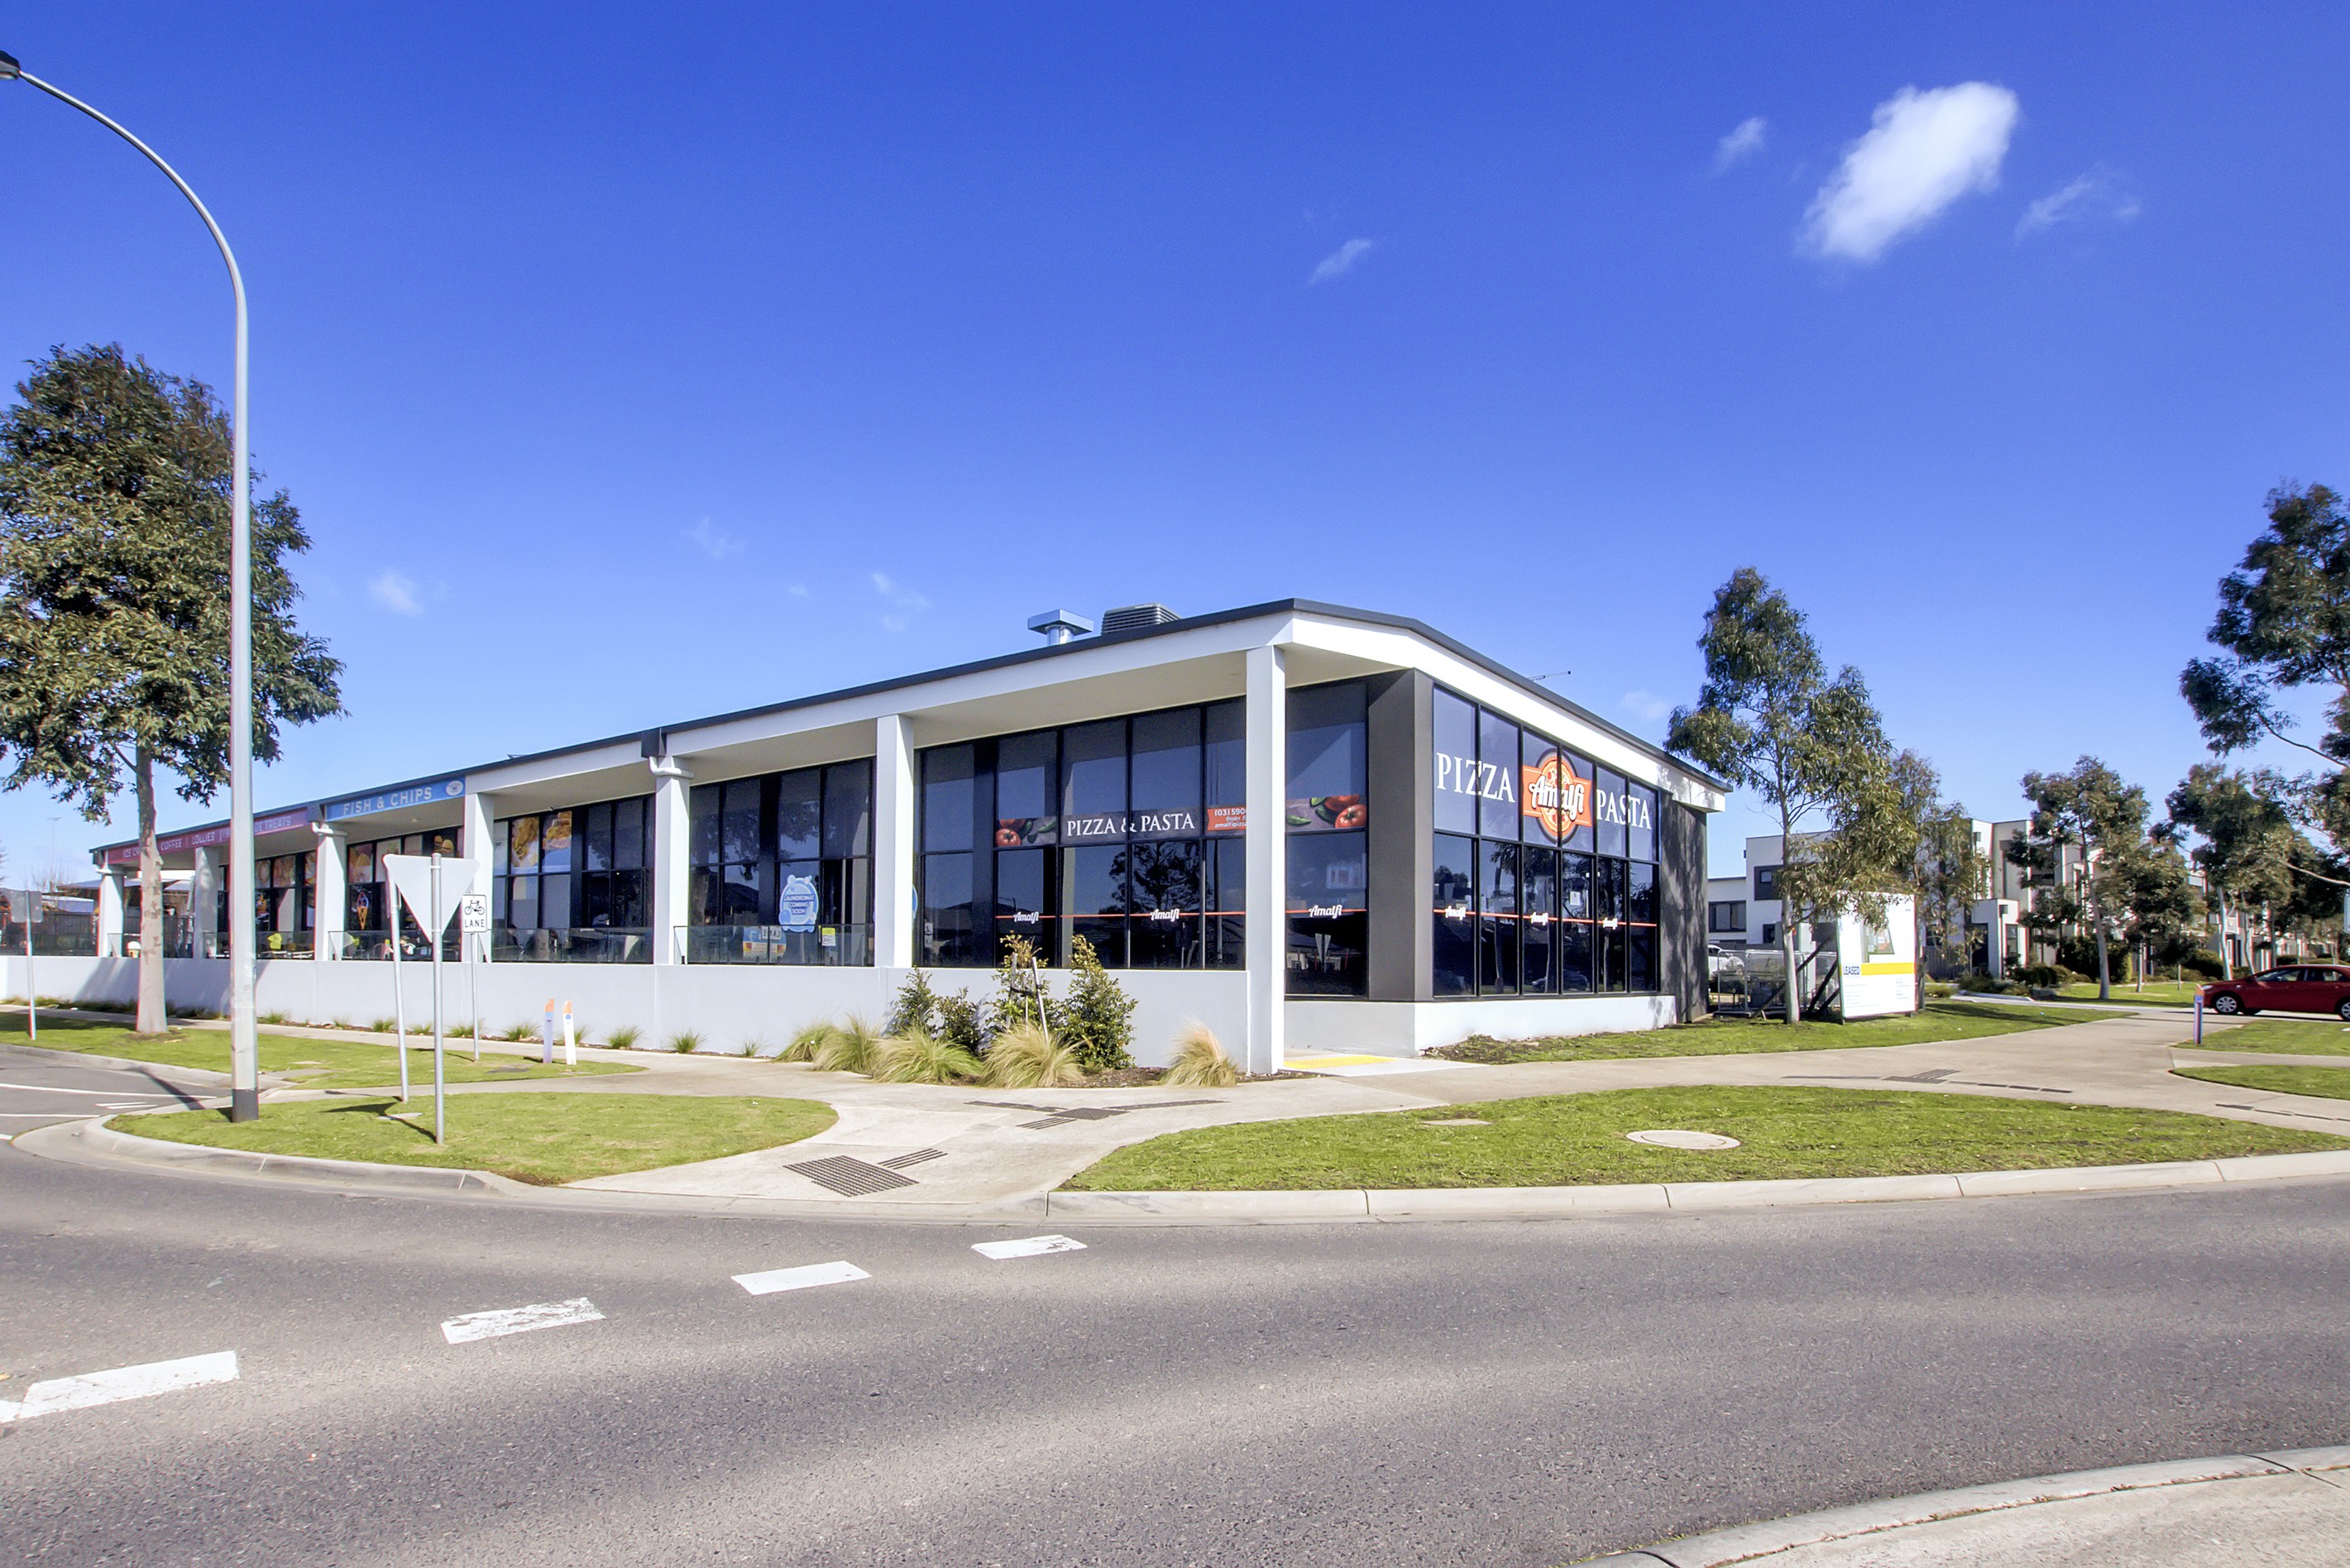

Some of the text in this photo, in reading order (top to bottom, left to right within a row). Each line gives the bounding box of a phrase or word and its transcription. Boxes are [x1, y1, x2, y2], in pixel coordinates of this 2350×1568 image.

[1436, 752, 1515, 803] PIZZA
[343, 786, 432, 816] FISH & CHIPS
[1529, 775, 1584, 820] Amalfi
[1214, 808, 1231, 816] (03)
[1596, 788, 1652, 829] PASTA
[1067, 812, 1195, 837] PIZZA & PASTA
[160, 838, 183, 851] COFFEE
[191, 831, 216, 845] LOLLIES
[1013, 911, 1040, 925] Amalfi
[1150, 908, 1180, 923] Amalfi
[1308, 904, 1343, 920] Amalfi
[464, 919, 485, 928] LANE
[1843, 965, 1860, 976] LEASED
